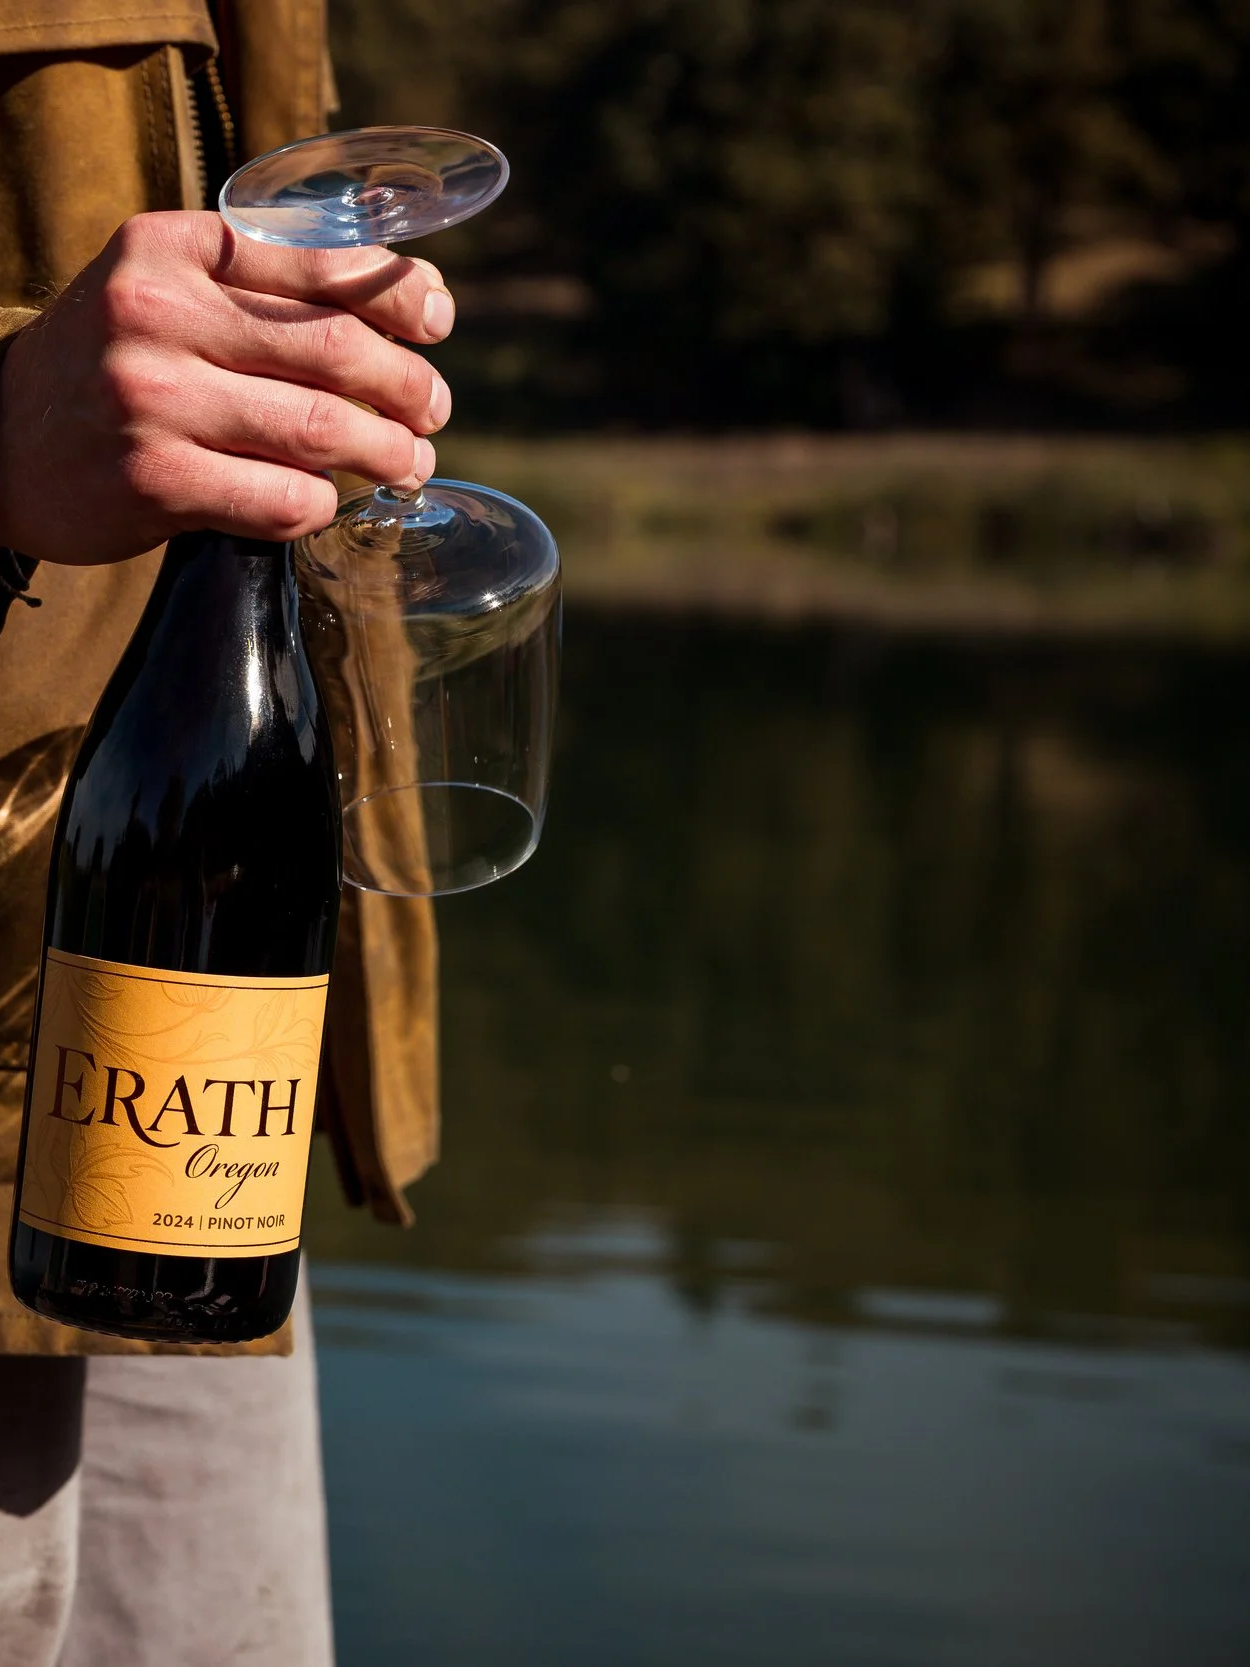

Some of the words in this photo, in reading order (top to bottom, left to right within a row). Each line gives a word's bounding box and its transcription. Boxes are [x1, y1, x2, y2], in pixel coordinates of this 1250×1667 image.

[48, 1044, 301, 1148] ERATH
[185, 1144, 279, 1209] Oregon
[153, 1213, 193, 1228] 2024
[208, 1217, 254, 1229] PINOT
[257, 1214, 285, 1228] NOIR
